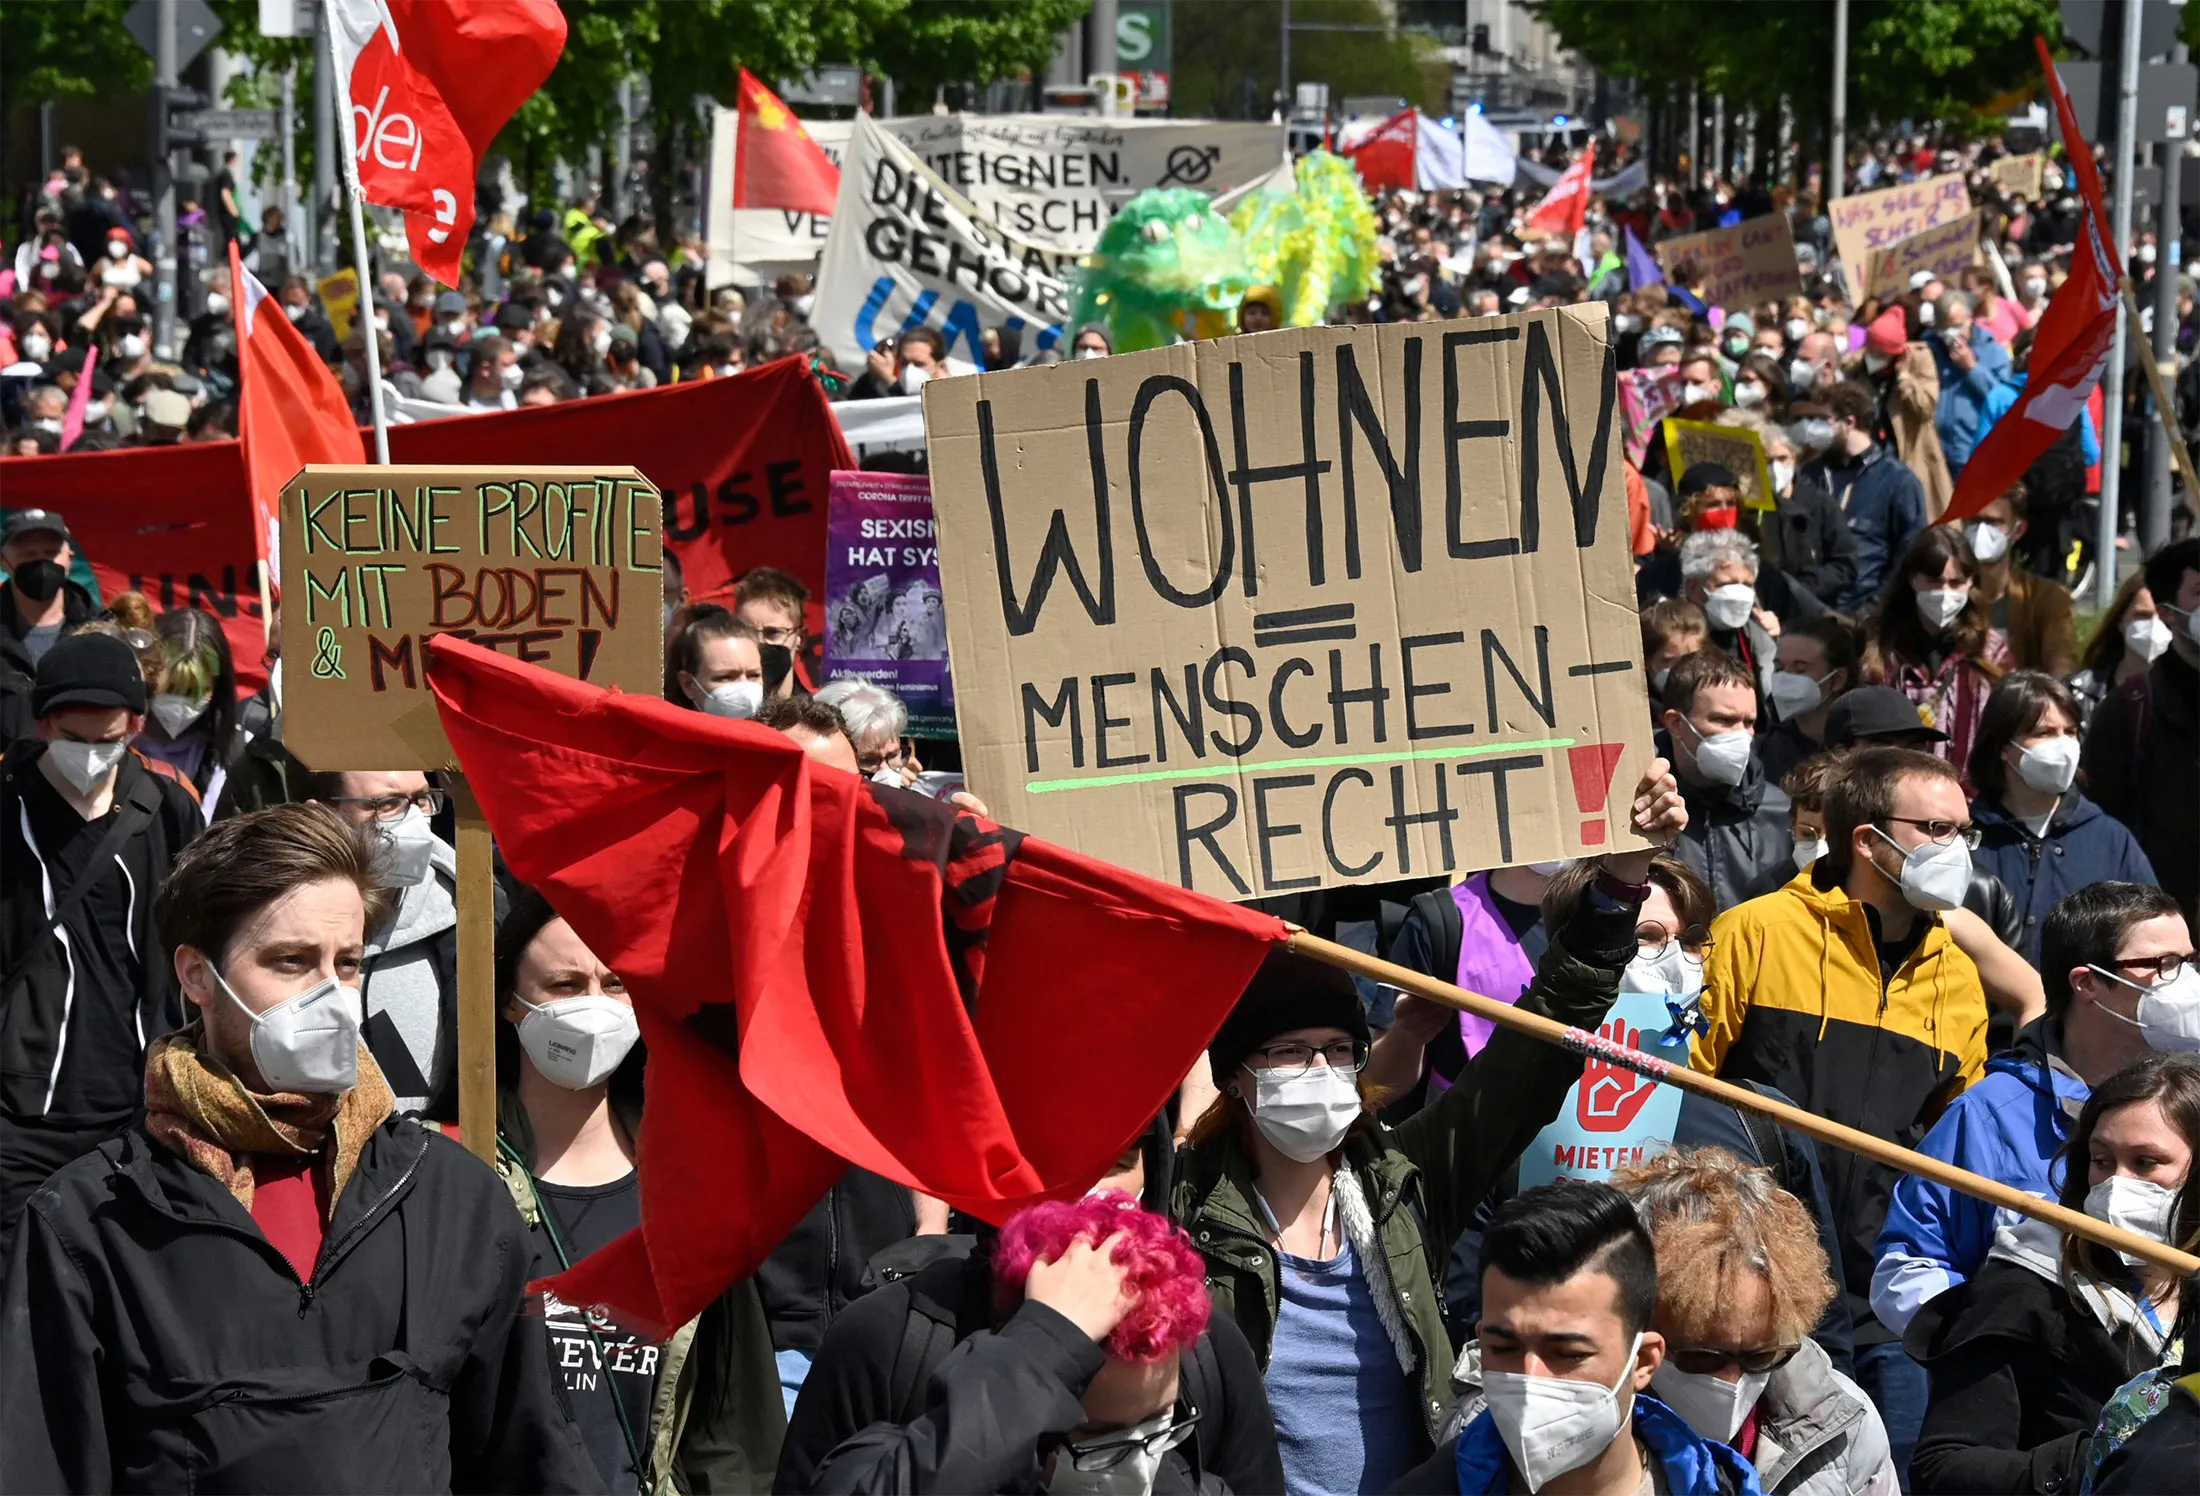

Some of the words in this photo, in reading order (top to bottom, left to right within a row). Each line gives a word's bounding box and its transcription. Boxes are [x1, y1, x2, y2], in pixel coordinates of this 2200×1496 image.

[1116, 12, 1152, 61] S
[926, 151, 1130, 188] TEIGNEN.
[854, 276, 1064, 372] UN
[976, 320, 1617, 637] WOHNEN
[299, 484, 462, 556] KEINE
[475, 475, 664, 574] PROFITE
[848, 546, 897, 567] HAT
[303, 563, 407, 629] MIT
[422, 562, 621, 631] BODEN
[311, 625, 348, 681] &
[1021, 625, 1633, 773] MENSCHEN-
[1555, 1144, 1644, 1169] MIETEN
